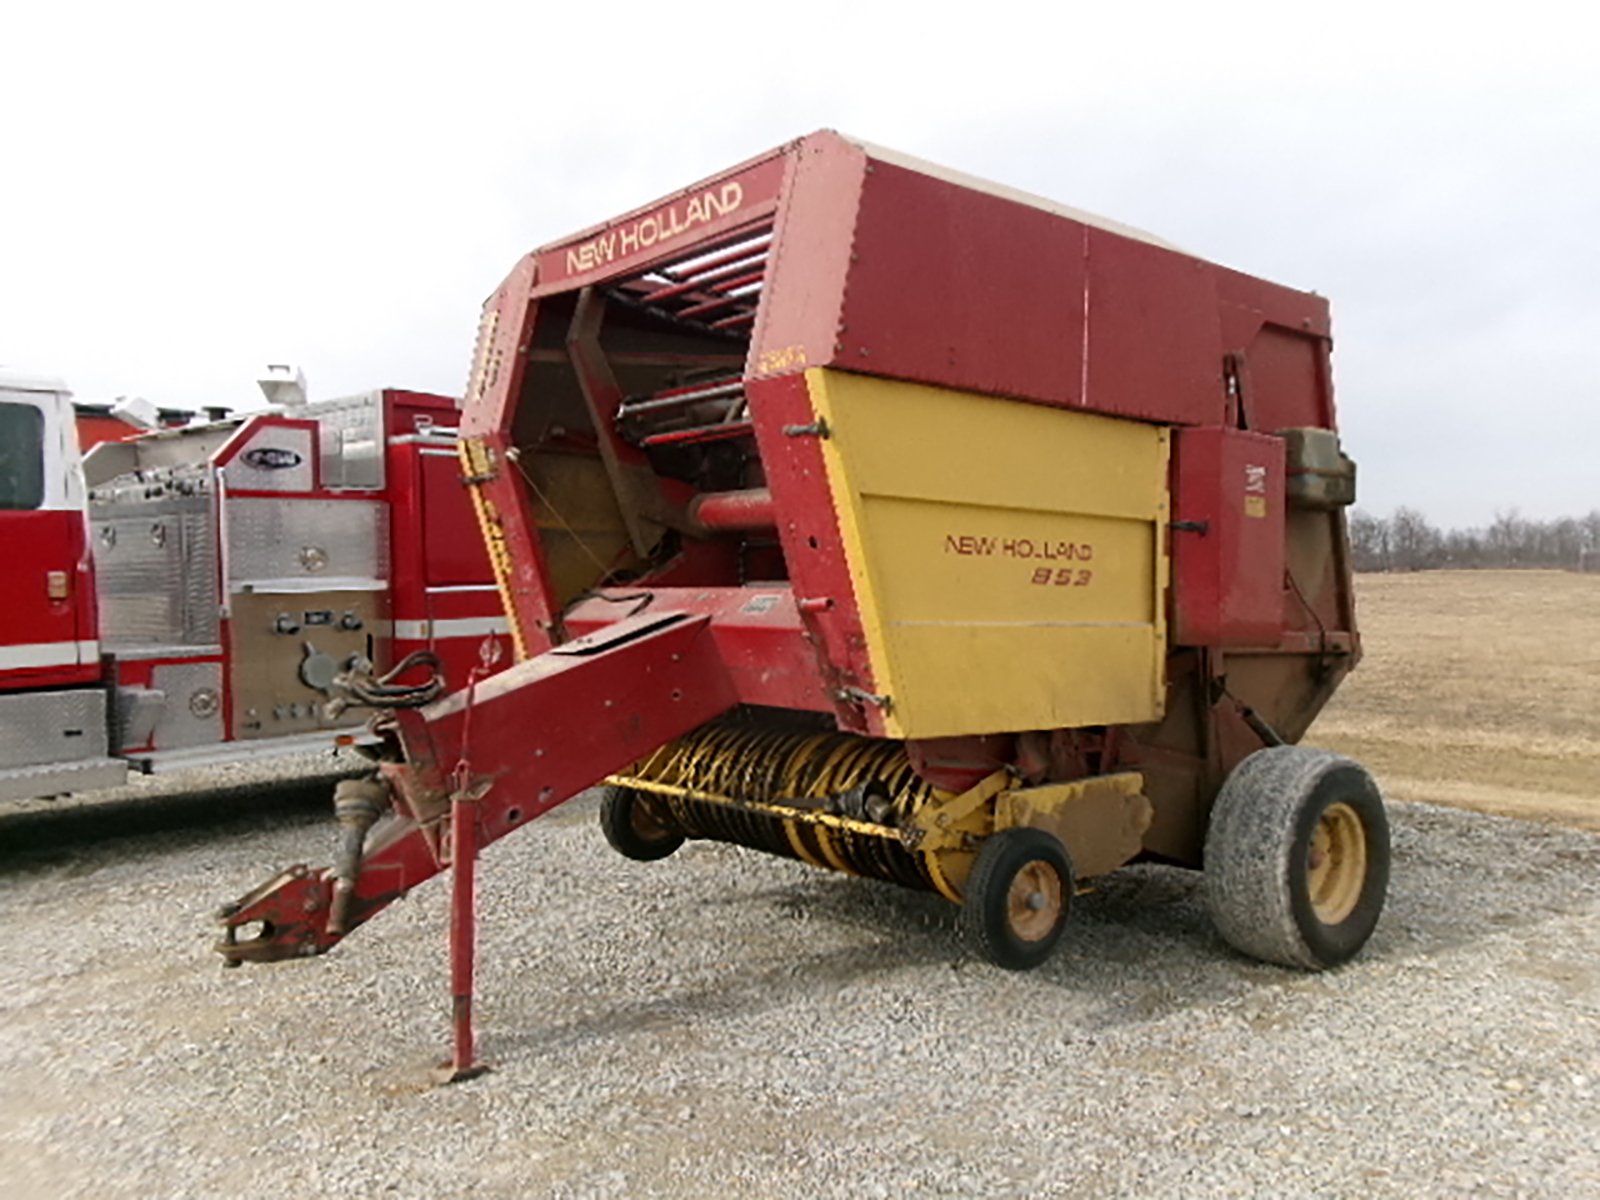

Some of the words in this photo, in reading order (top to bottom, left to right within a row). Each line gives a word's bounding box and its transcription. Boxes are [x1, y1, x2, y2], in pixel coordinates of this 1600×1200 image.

[567, 231, 616, 275] NEW
[620, 182, 743, 255] HOLLAND
[945, 534, 997, 555] NEW
[1031, 566, 1092, 586] 853
